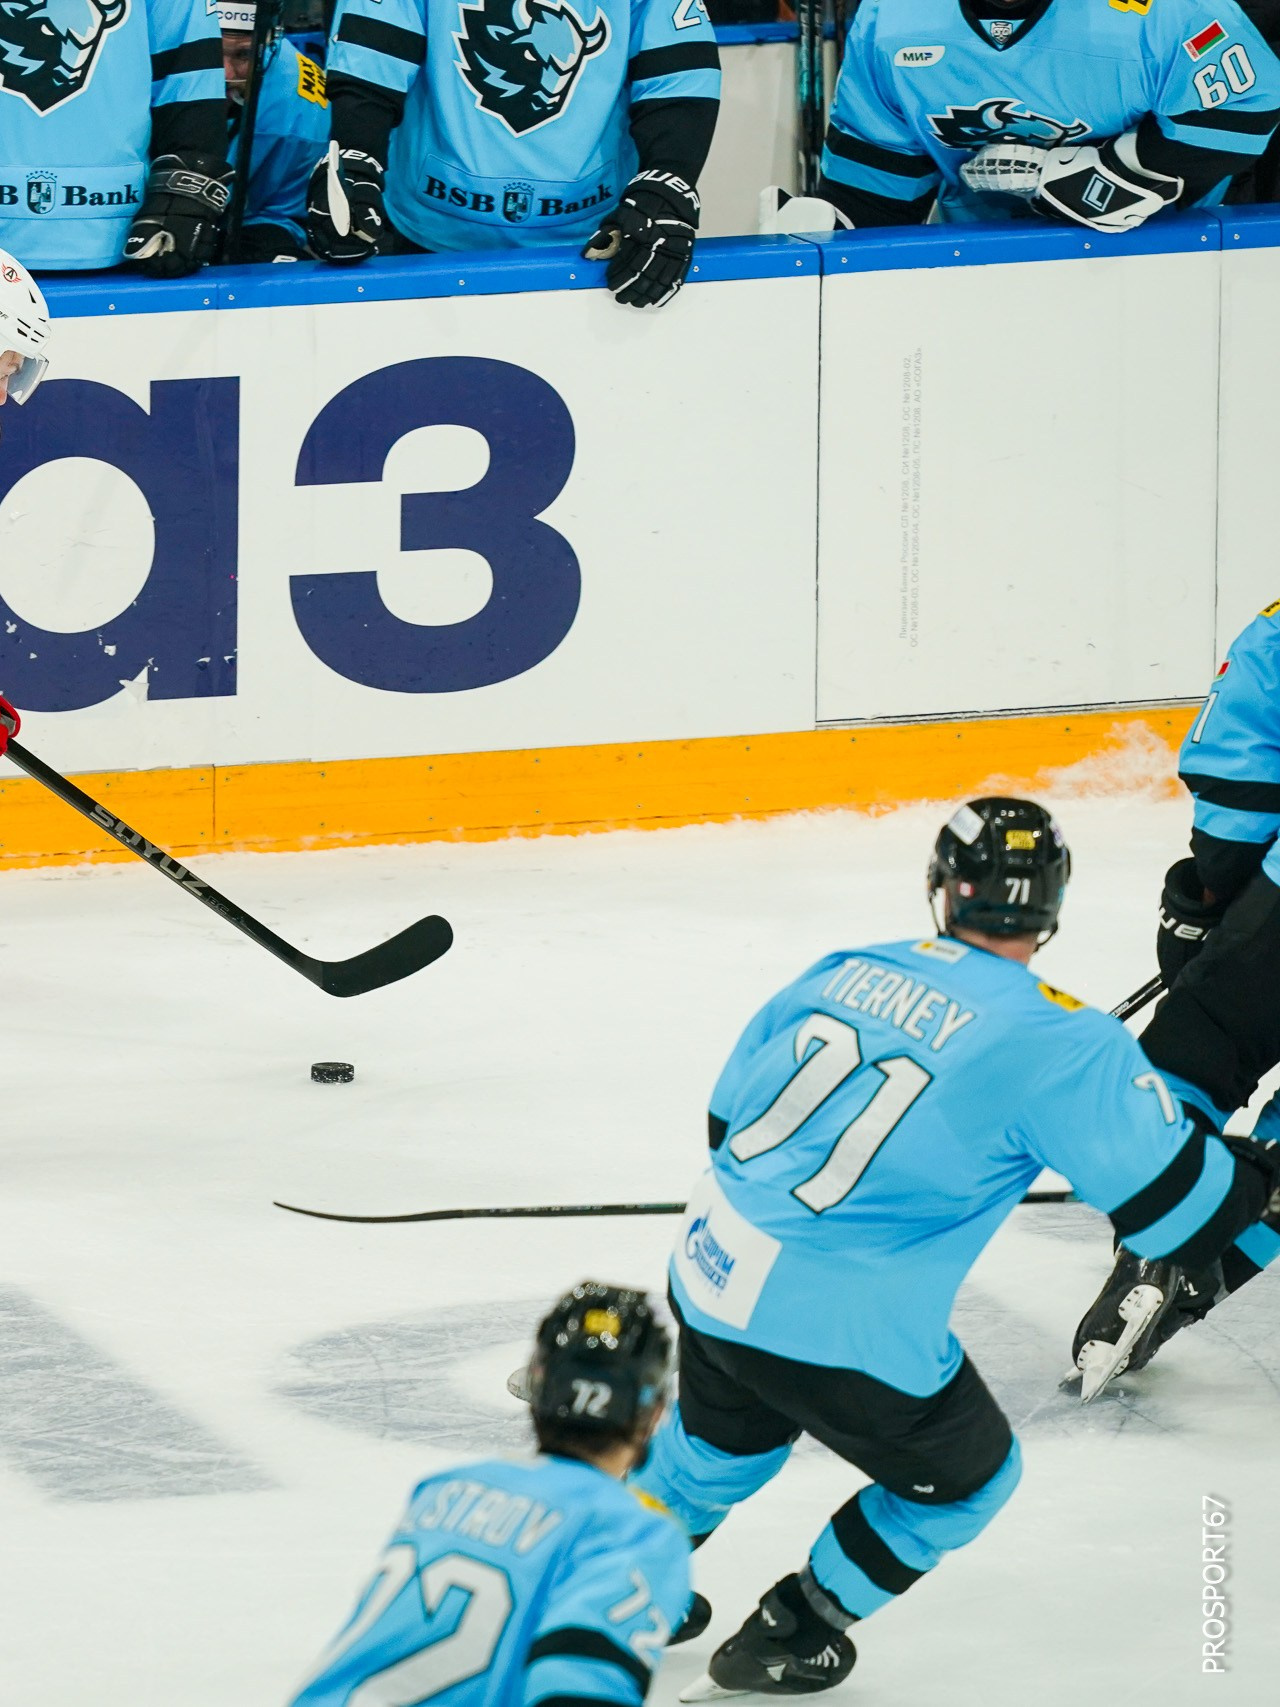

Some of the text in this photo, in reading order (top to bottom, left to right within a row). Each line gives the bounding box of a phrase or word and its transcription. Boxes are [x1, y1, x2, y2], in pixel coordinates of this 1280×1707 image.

[903, 52, 933, 61] МИР
[1193, 43, 1256, 109] 60
[61, 184, 139, 207] Bank
[422, 175, 613, 217] BSB Bank
[90, 804, 208, 897] SOYUZ
[1005, 877, 1031, 905] 71
[821, 957, 976, 1052] TIERNEY
[728, 1010, 934, 1216] 71
[571, 1378, 613, 1419] 72
